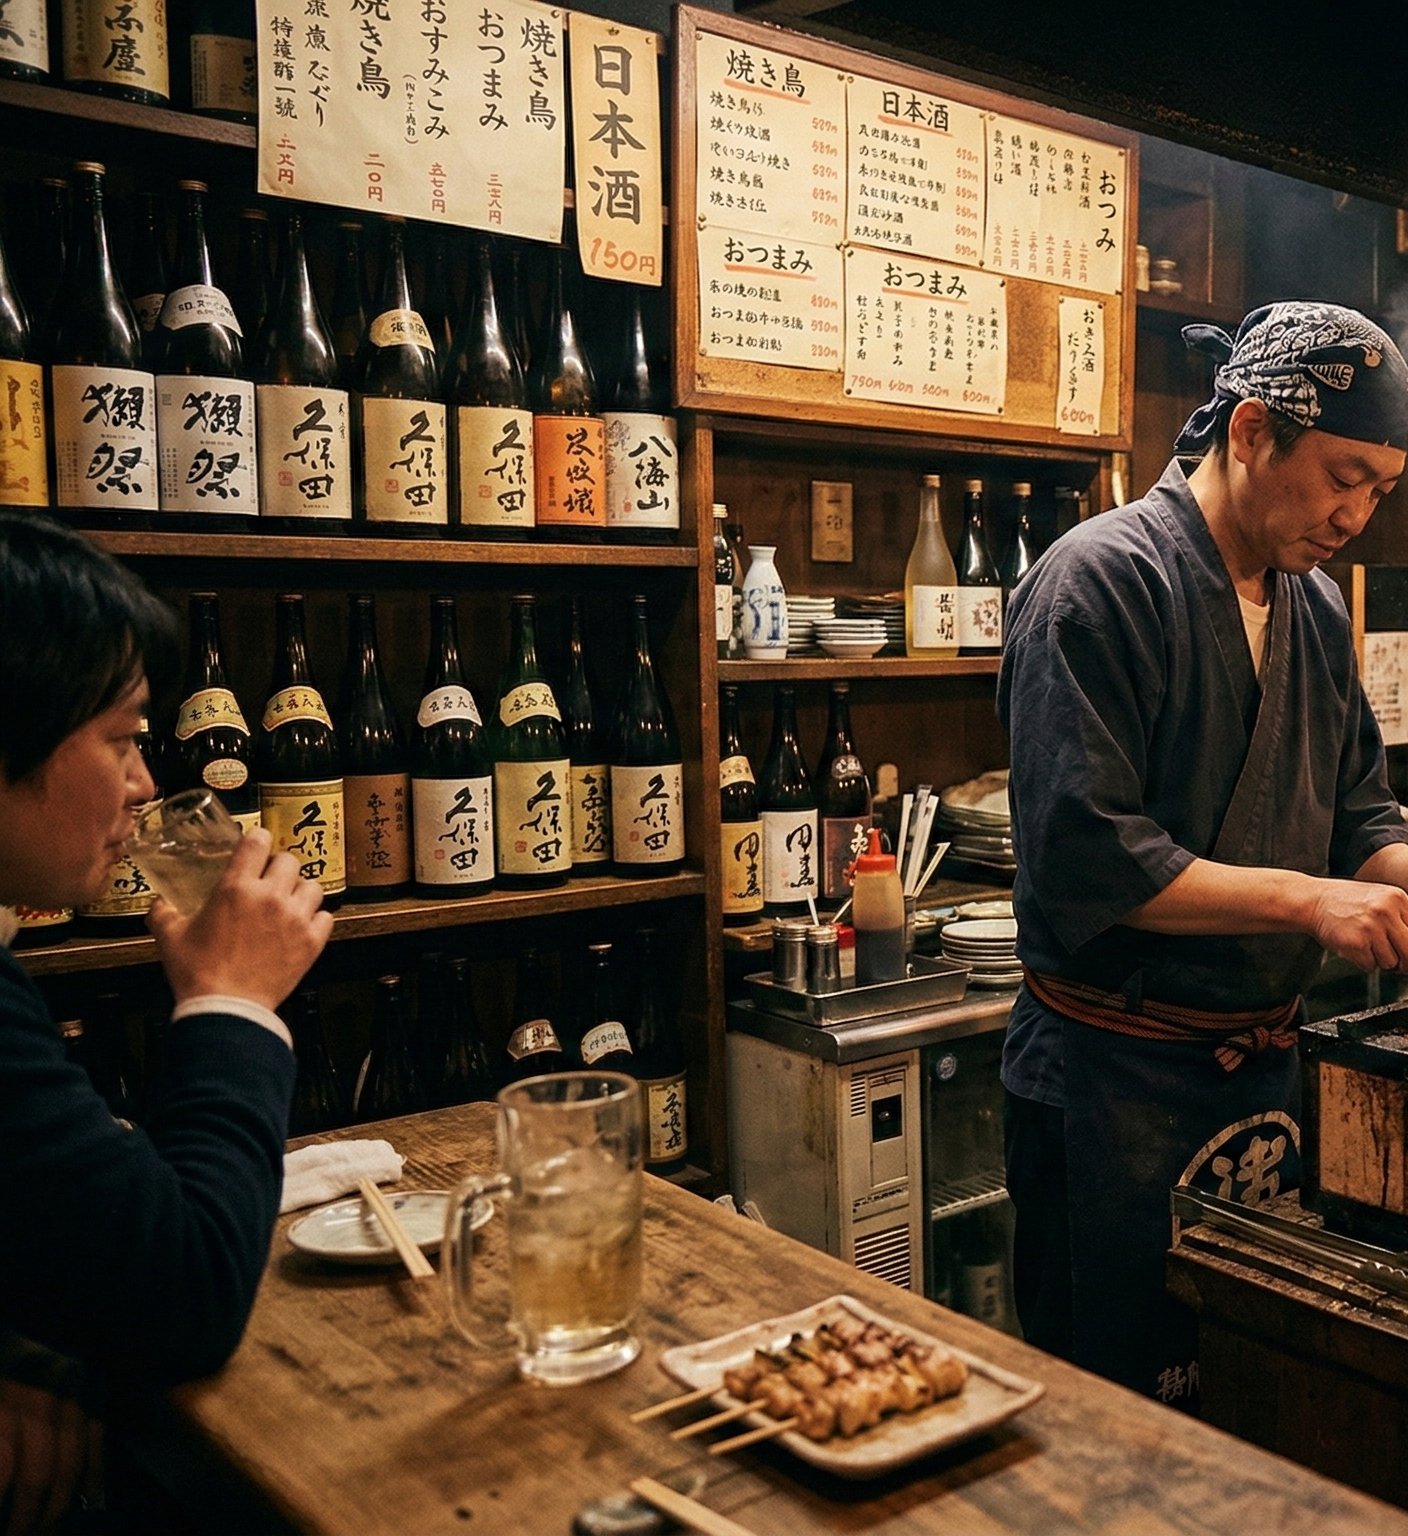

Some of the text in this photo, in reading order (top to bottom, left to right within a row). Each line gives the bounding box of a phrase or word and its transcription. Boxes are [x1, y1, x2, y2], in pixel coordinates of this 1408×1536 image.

[477, 7, 509, 132] おつまみ
[519, 17, 558, 131] 焼き鳥
[726, 48, 806, 98] 焼き鳥
[882, 90, 949, 132] 日本酒
[588, 43, 647, 226] 日本酒
[1095, 170, 1117, 253] おつみ
[589, 237, 656, 277] 150円
[723, 236, 813, 275] おつまみ
[883, 262, 968, 299] おつまみ
[283, 398, 336, 500] 久保田
[389, 410, 437, 507] 久保田
[484, 419, 527, 513] 久保田
[627, 435, 673, 511] 八海山
[287, 800, 328, 880] 久保田
[438, 786, 480, 871] 久保田
[518, 770, 563, 864] 久保田
[633, 773, 671, 851] 久保田
